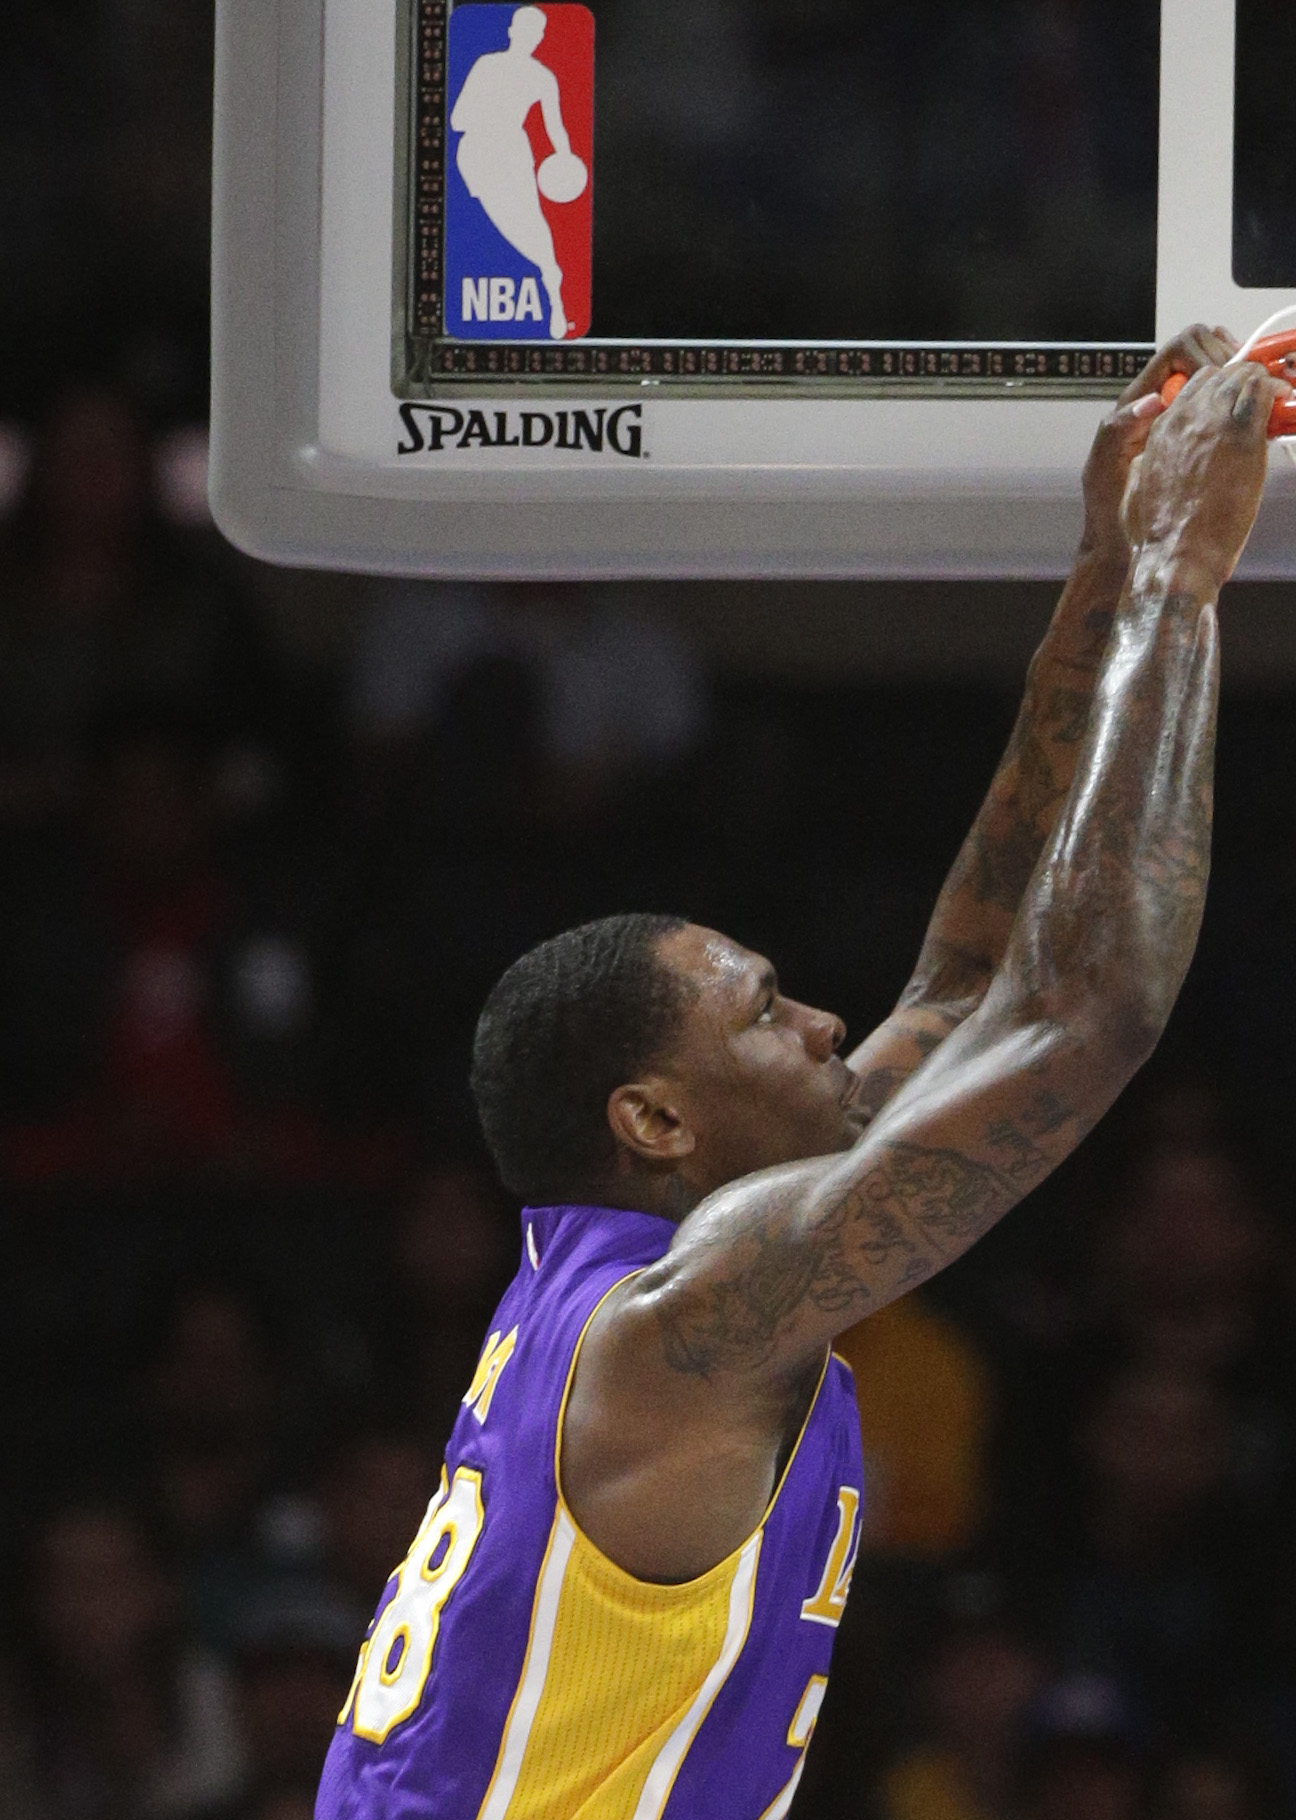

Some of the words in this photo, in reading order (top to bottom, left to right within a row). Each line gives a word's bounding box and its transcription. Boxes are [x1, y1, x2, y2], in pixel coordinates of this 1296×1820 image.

[461, 277, 543, 322] NBA
[397, 402, 650, 458] SPALDING
[337, 1463, 486, 1746] 8
